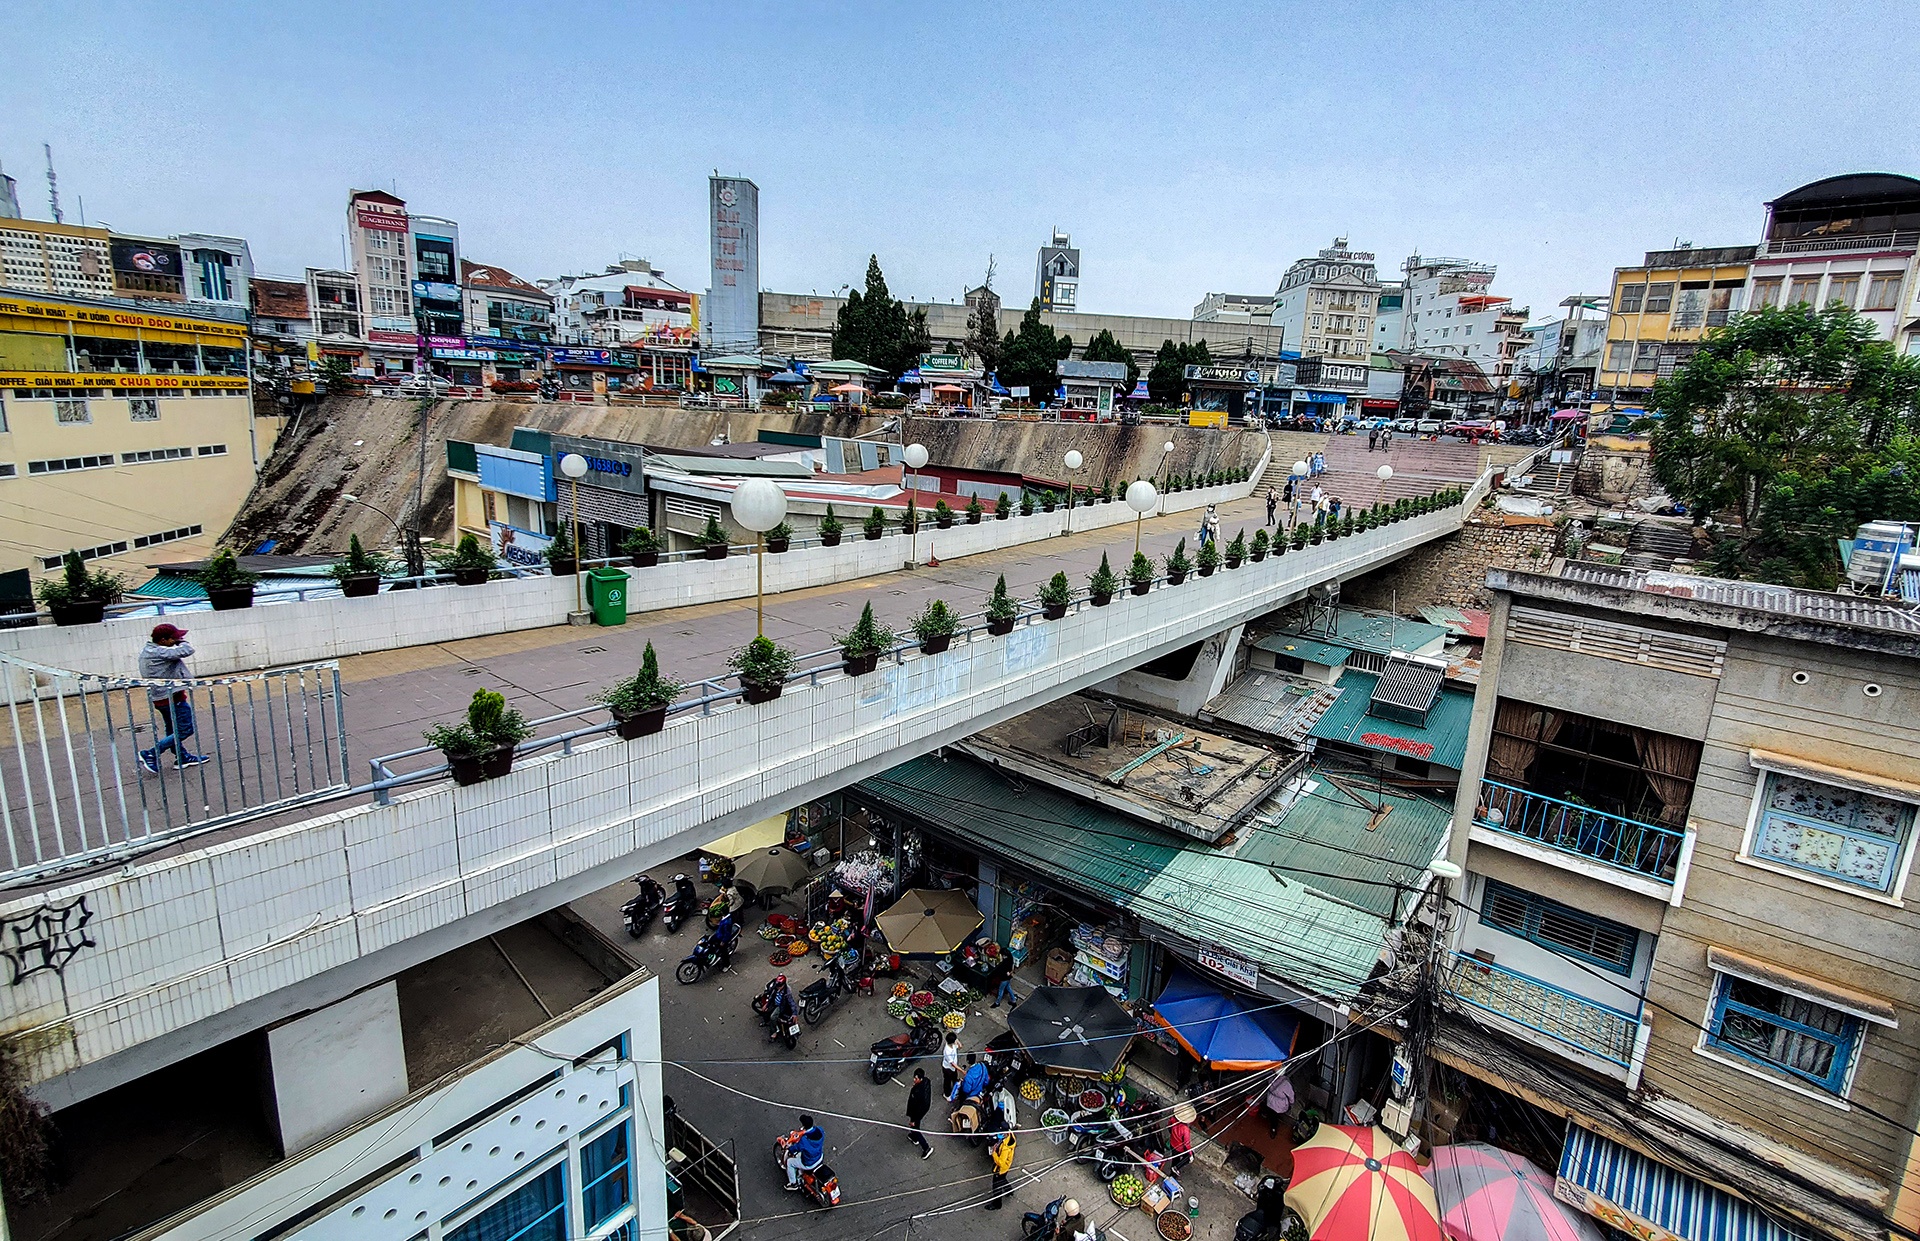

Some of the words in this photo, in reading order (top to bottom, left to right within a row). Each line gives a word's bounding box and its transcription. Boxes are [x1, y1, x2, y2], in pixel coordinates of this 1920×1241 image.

[367, 217, 406, 227] AGRIBANK
[932, 357, 948, 365] COFFEE
[1201, 956, 1225, 972] 102
